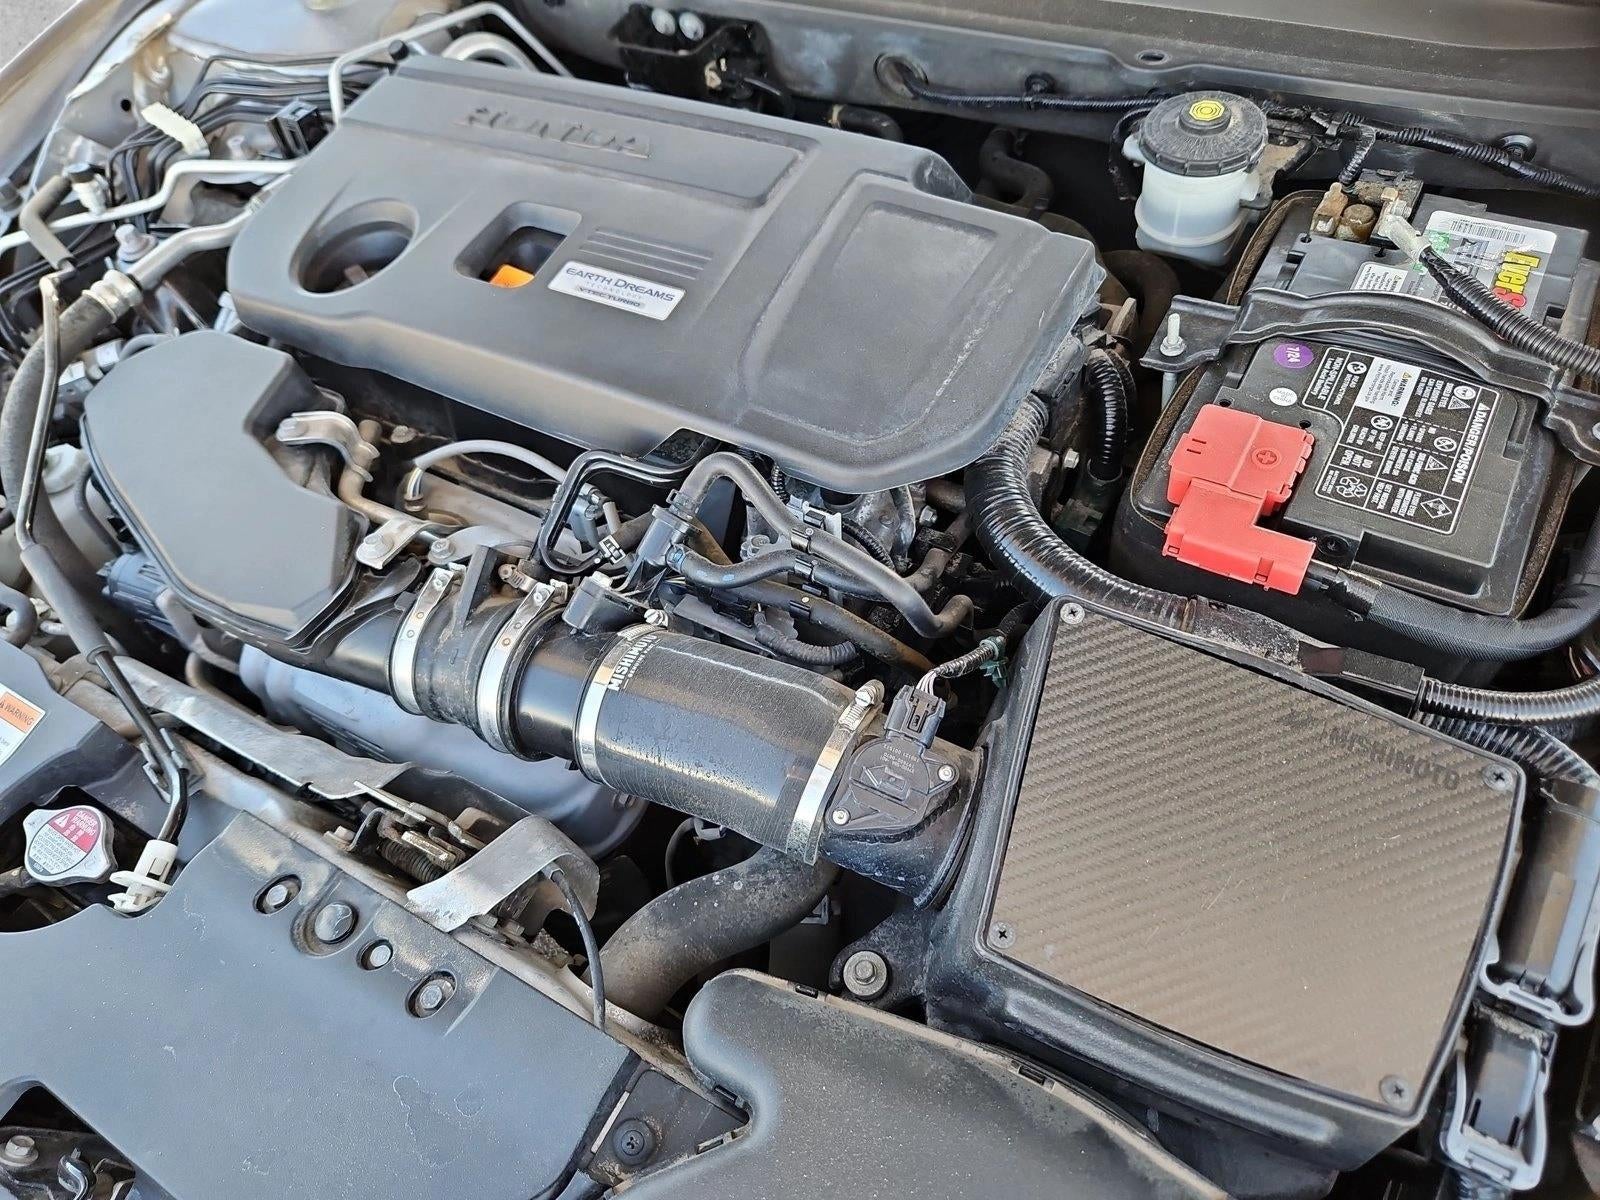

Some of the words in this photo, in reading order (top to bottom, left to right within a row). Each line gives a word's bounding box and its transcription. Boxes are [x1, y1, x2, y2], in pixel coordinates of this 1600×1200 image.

[566, 267, 613, 285] EARTH
[615, 279, 676, 302] DREAMS
[1492, 250, 1540, 309] EverS
[1323, 356, 1335, 369] Lead
[1316, 356, 1344, 401] NON-SPILLABLE
[1318, 368, 1329, 380] Acid
[1309, 378, 1324, 396] Battery
[1390, 377, 1408, 407] WARNING:
[1451, 409, 1487, 484] DANGER/POISON
[1338, 448, 1355, 467] OPEN.
[1350, 453, 1364, 467] NOT
[1360, 458, 1373, 469] DO
[5, 703, 34, 726] WARNING
